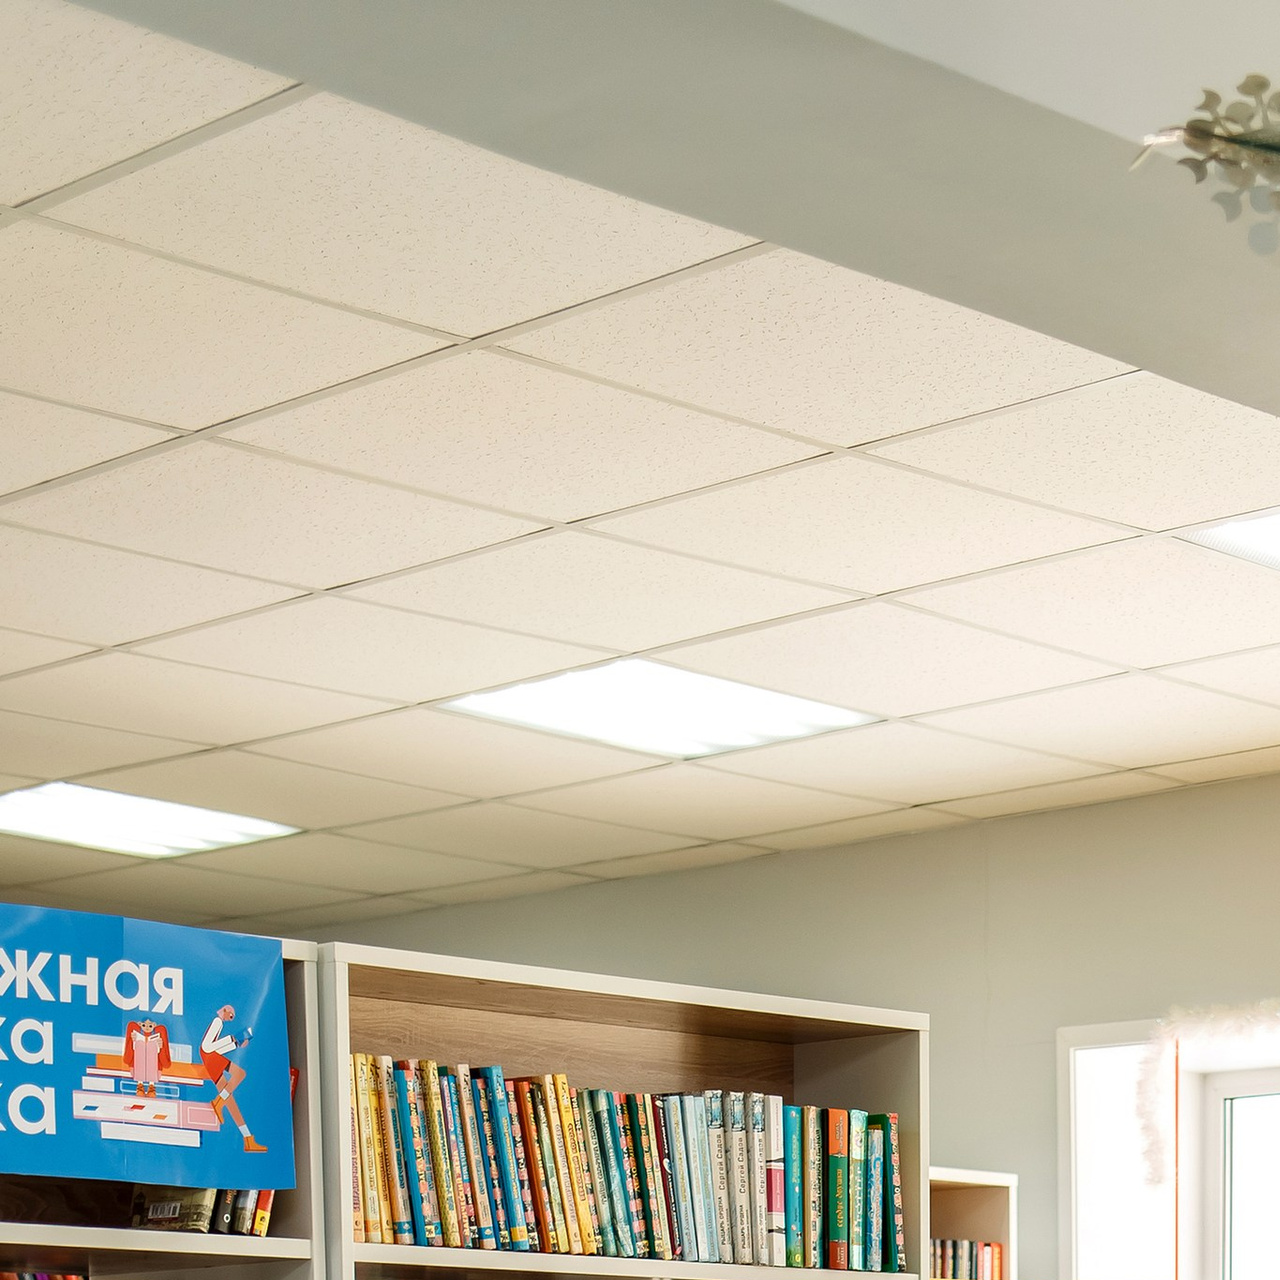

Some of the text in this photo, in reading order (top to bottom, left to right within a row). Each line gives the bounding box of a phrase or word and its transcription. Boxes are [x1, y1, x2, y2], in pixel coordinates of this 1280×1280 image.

[0, 1018, 54, 1065] а
[0, 1083, 57, 1136] а
[715, 1134, 723, 1159] Садов
[736, 1137, 744, 1162] Садов
[718, 1161, 726, 1190] Сергей
[738, 1165, 746, 1194] Сергей
